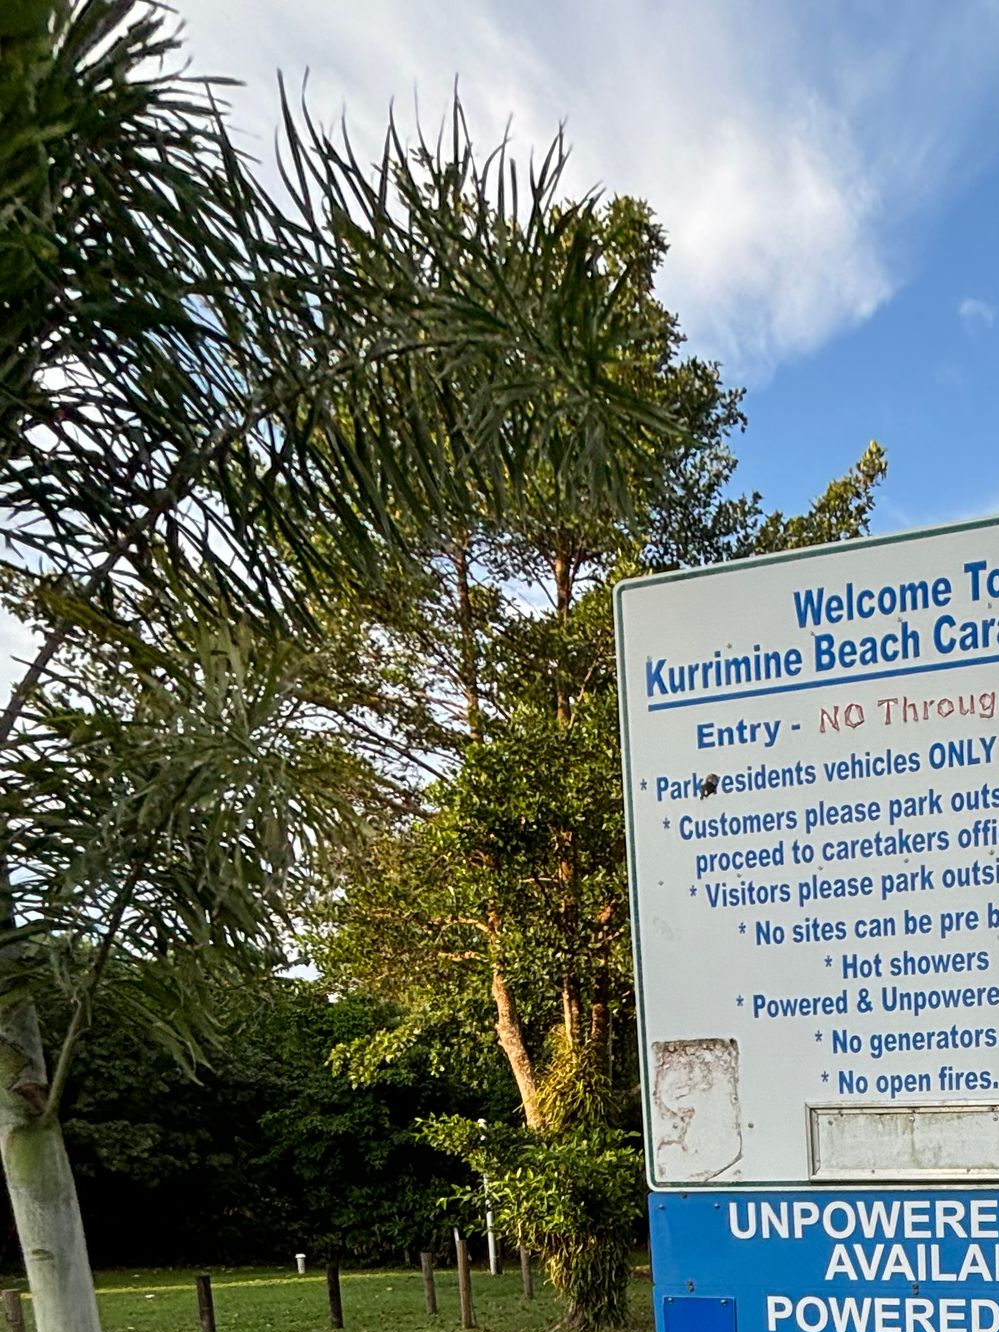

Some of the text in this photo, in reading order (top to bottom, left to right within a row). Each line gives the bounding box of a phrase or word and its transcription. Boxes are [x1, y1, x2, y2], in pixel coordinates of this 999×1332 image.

[793, 575, 953, 629] Welcome
[646, 643, 803, 697] Kurrimine
[814, 621, 920, 673] Beach
[696, 718, 781, 749] Entry
[819, 703, 865, 733] NO
[656, 775, 703, 801] Park
[825, 750, 921, 781] vehicles
[928, 735, 995, 769] ONLY
[679, 810, 797, 840] Customers
[805, 801, 881, 832] please
[888, 789, 941, 823] park
[695, 842, 785, 875] proceed
[791, 841, 815, 864] to
[822, 830, 949, 861] caretakers
[705, 882, 791, 907] Visitors
[798, 875, 873, 906] please
[881, 864, 933, 897] park
[755, 920, 785, 945] No
[793, 918, 847, 941] sites
[854, 916, 897, 939] can
[903, 910, 933, 934] be
[940, 909, 979, 936] pre
[841, 951, 989, 978] Hot showers
[752, 991, 849, 1017] Powered
[856, 987, 873, 1014] &
[831, 1029, 863, 1053] No
[837, 1066, 999, 1096] No open fires.
